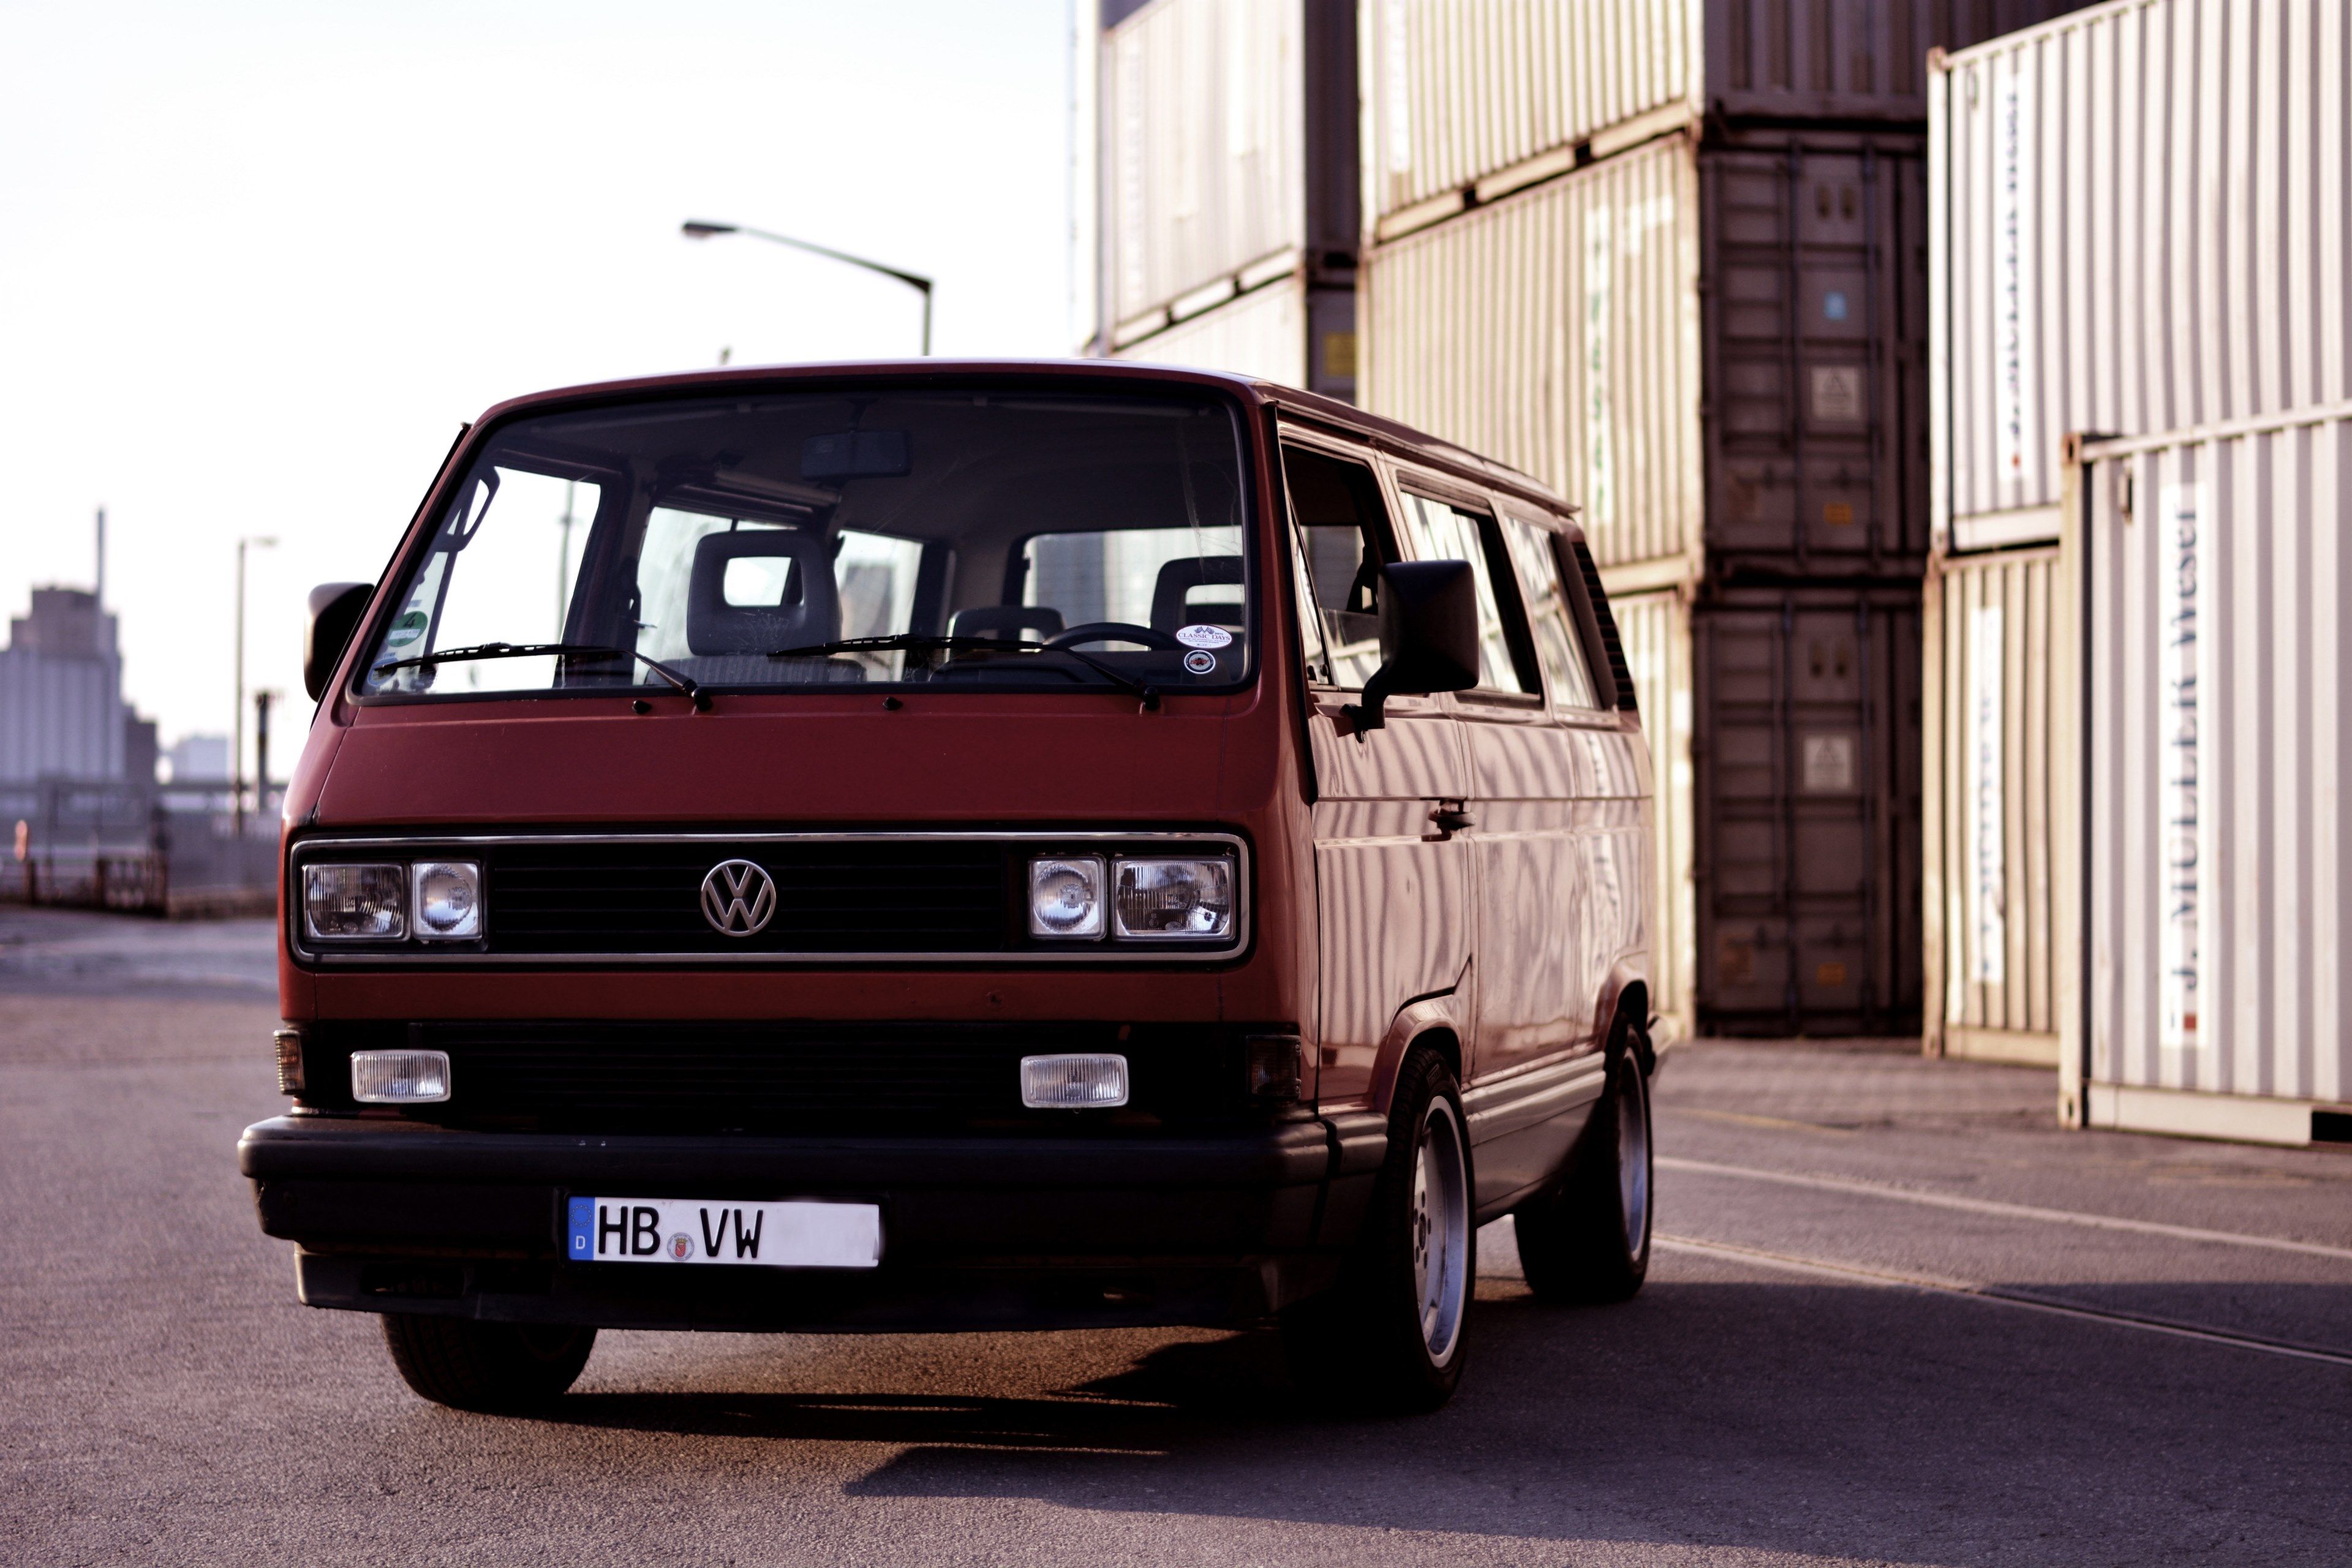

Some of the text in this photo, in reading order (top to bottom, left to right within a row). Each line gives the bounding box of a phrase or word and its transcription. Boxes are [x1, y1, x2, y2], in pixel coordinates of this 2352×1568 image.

[2168, 502, 2197, 649] Weser
[701, 859, 776, 937] VW
[576, 1235, 586, 1250] D
[598, 1205, 661, 1255] HB
[700, 1207, 764, 1259] VW
